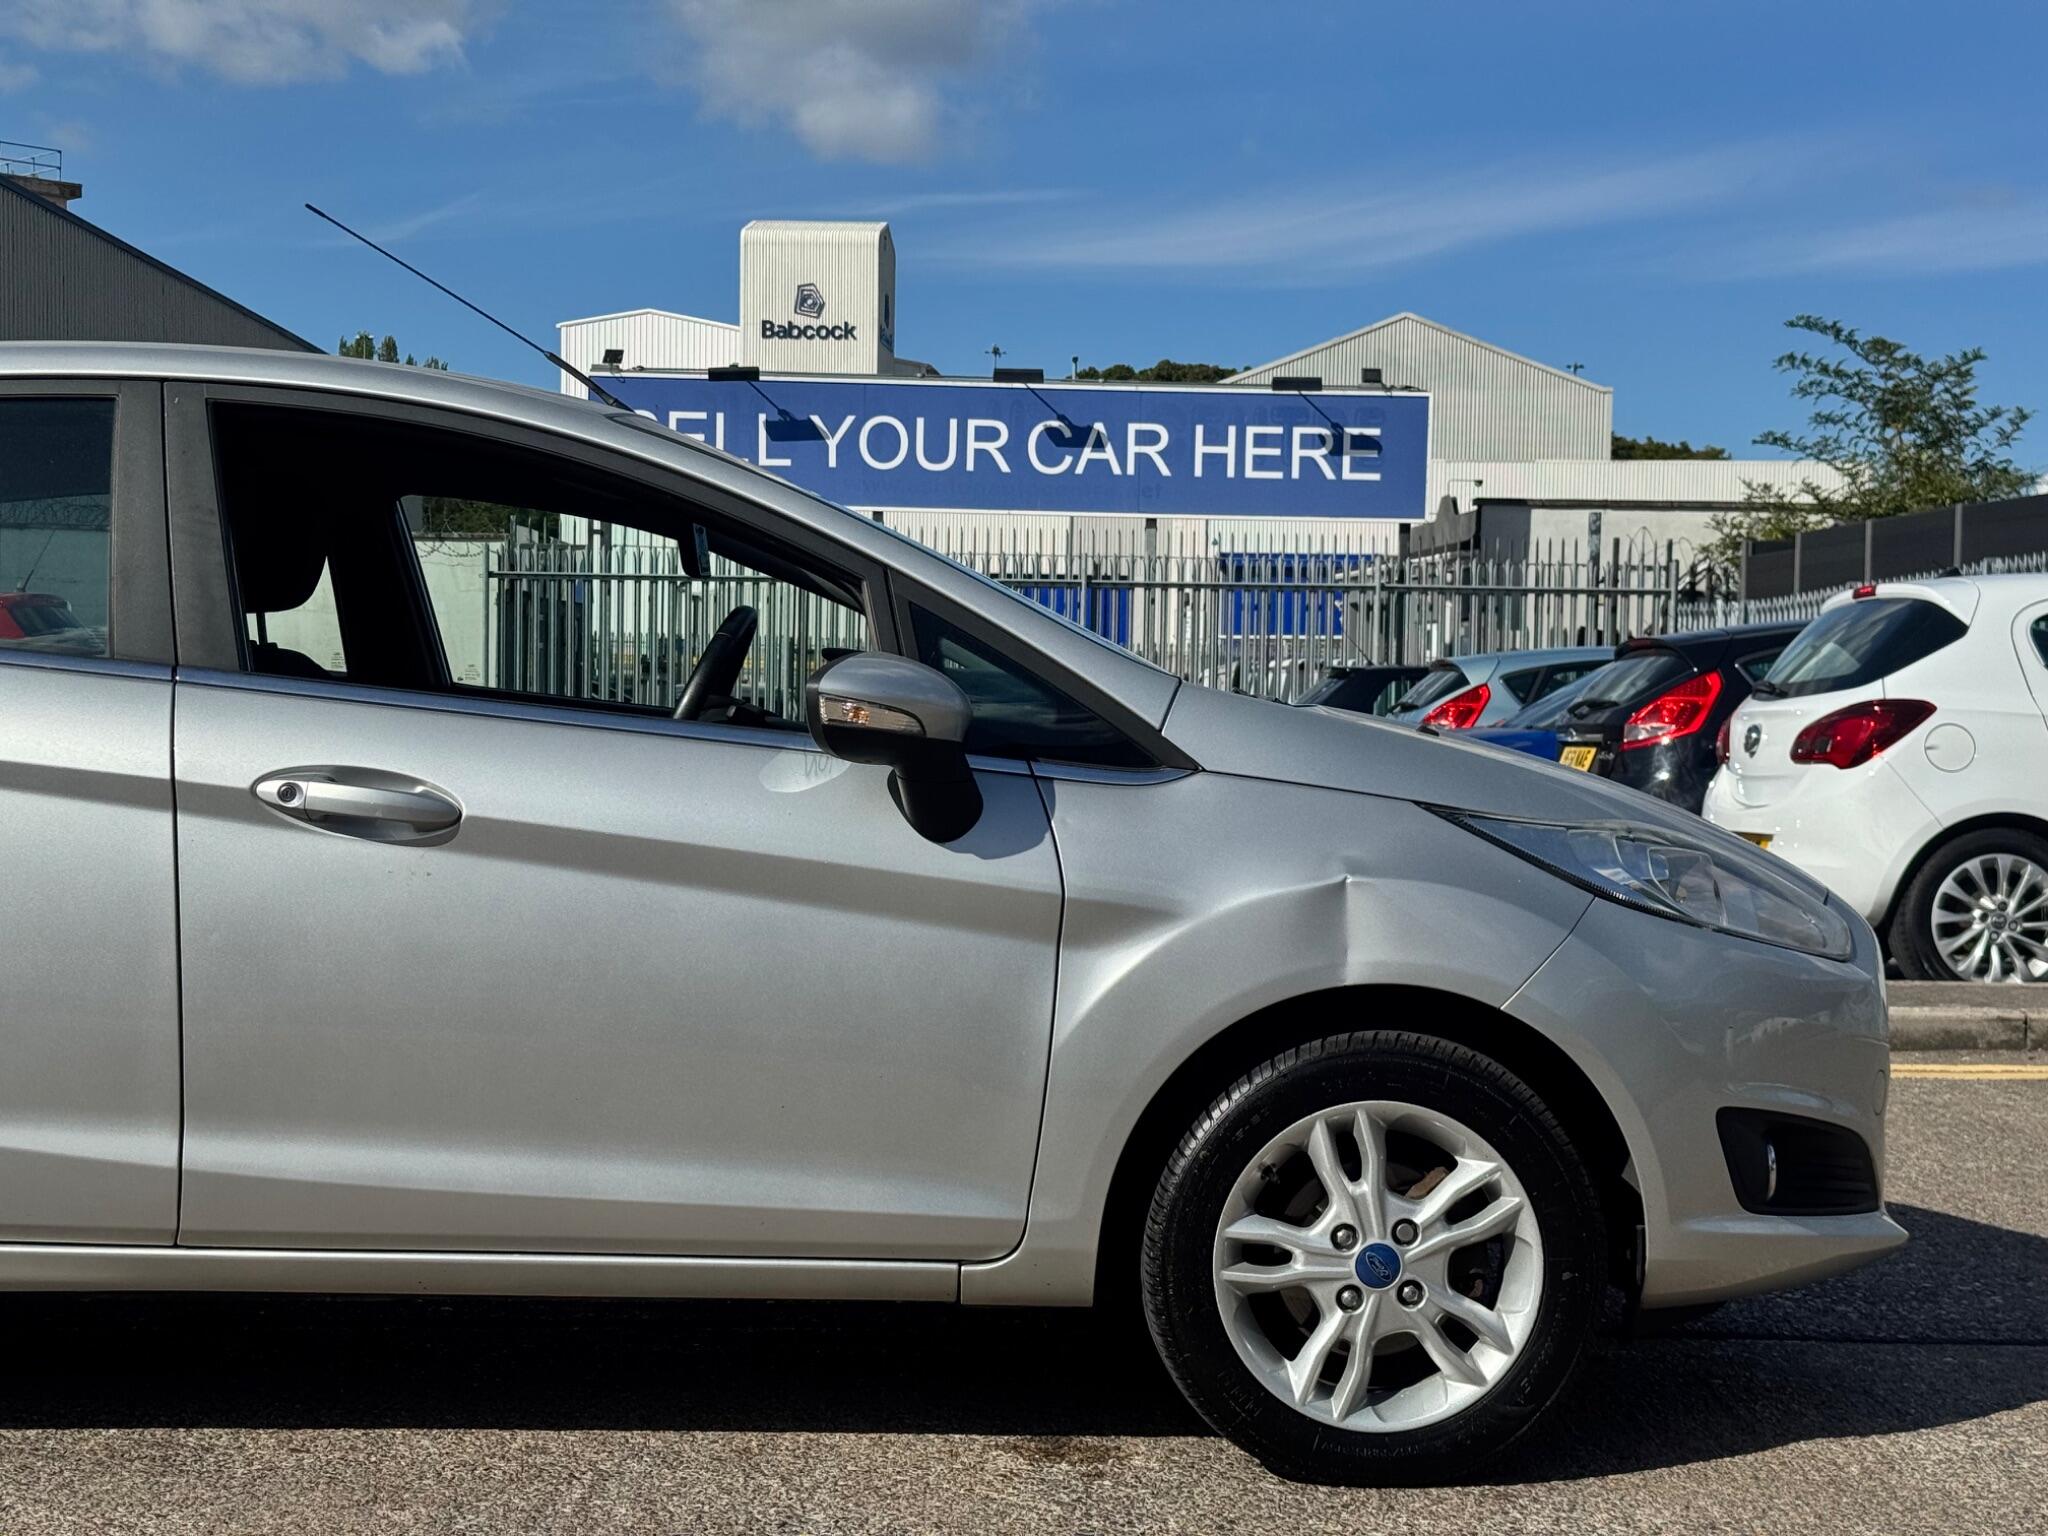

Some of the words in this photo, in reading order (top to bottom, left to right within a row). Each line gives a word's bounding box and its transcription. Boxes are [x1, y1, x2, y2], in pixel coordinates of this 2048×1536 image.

[762, 320, 857, 340] Babcock
[635, 410, 792, 467] ELL
[809, 414, 1012, 474] YOUR
[1027, 420, 1172, 477] CAR
[1194, 425, 1382, 481] HERE
